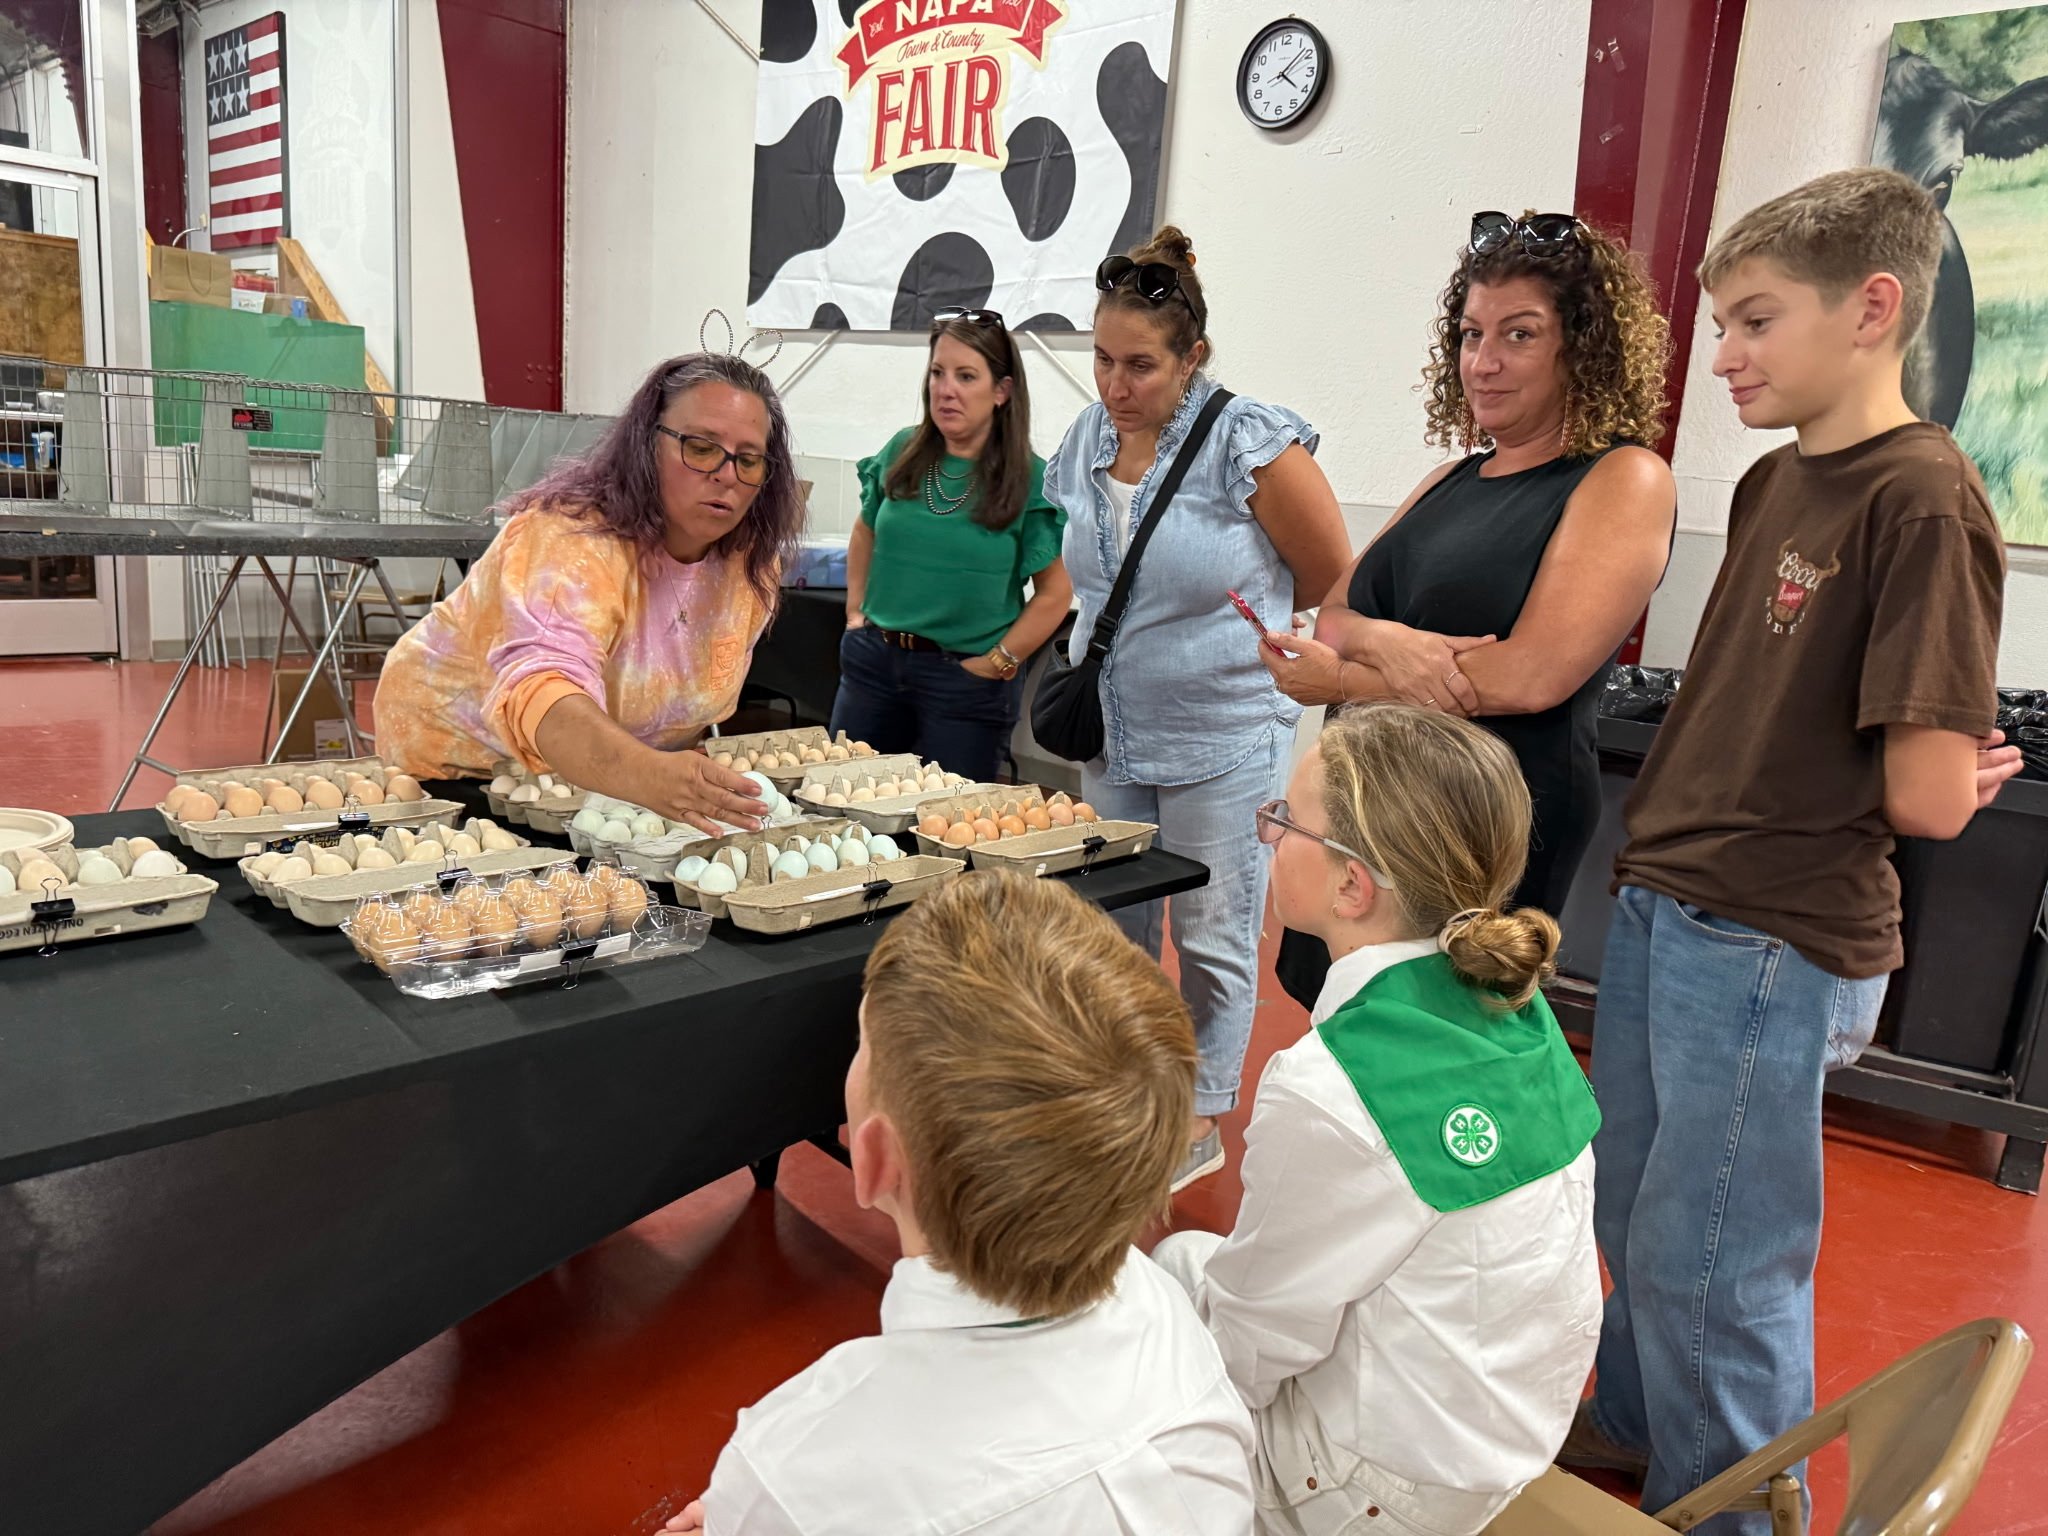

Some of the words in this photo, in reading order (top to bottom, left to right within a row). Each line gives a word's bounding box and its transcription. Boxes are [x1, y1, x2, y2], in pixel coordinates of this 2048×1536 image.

[897, 39, 930, 63] Town
[930, 32, 941, 52] &
[941, 27, 985, 53] Country
[1269, 38, 1277, 52] 11
[1281, 34, 1293, 46] 12
[1304, 48, 1314, 60] 2
[1257, 55, 1267, 67] 10
[1251, 72, 1260, 83] 9
[1305, 66, 1315, 78] 3
[1253, 89, 1263, 99] 8
[1301, 84, 1309, 94] 4
[1263, 101, 1270, 112] 7
[1289, 98, 1298, 109] 5
[870, 55, 1003, 173] FAIR
[1274, 105, 1283, 116] 6
